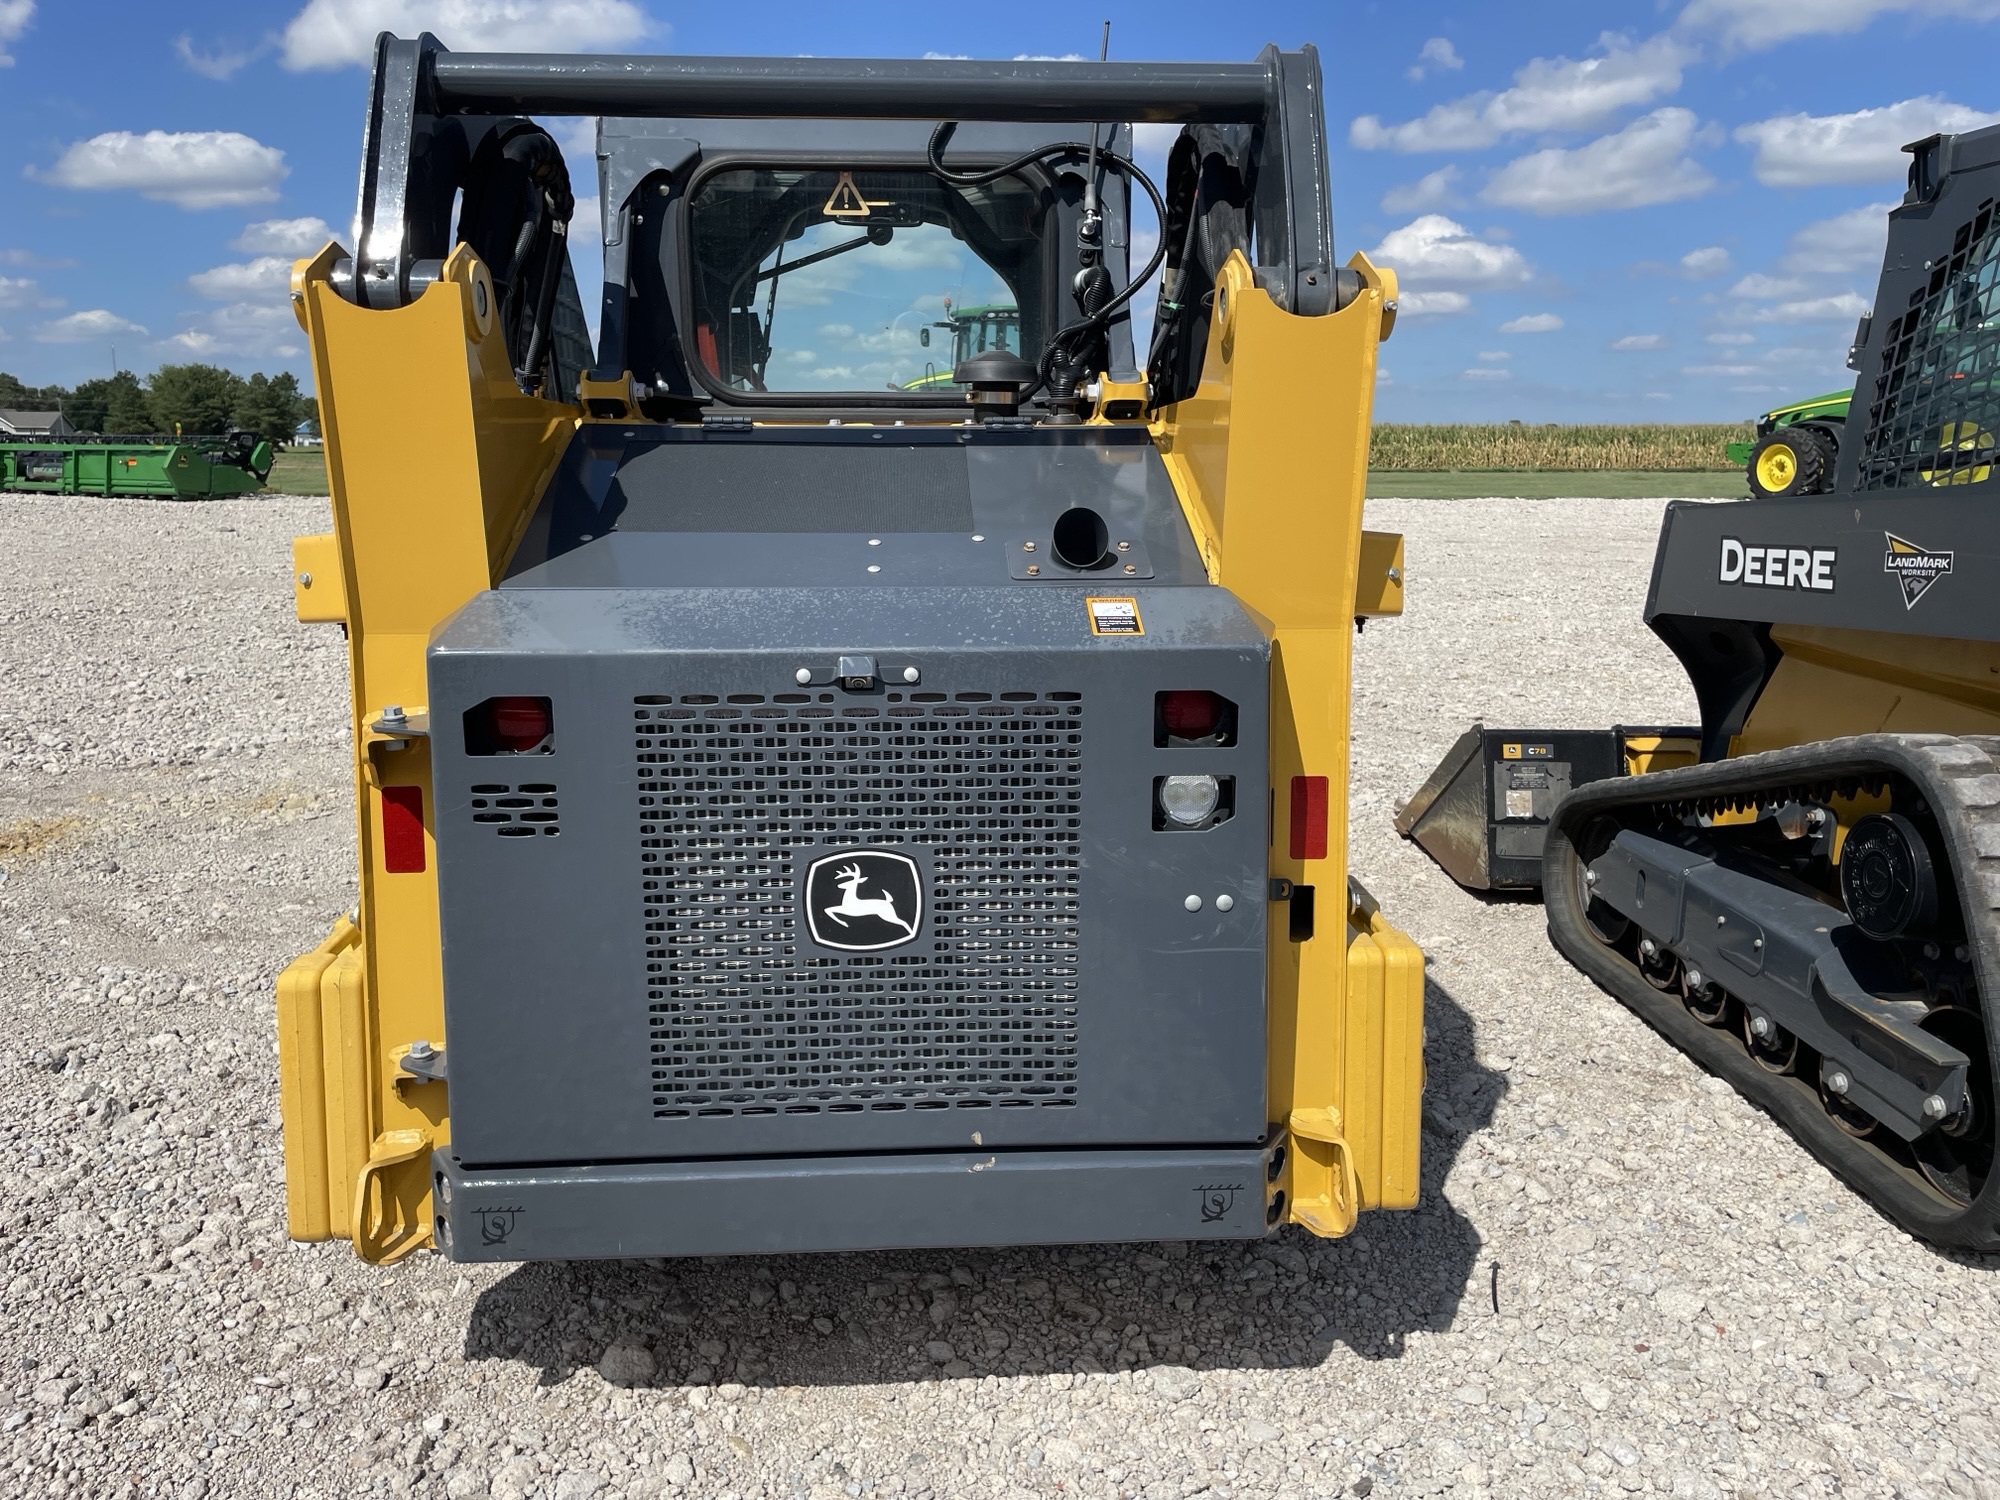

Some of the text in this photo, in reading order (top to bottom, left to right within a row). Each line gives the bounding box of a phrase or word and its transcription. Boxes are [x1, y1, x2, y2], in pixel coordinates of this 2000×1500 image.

[1720, 539, 1835, 590] DEERE
[1901, 569, 1936, 577] WORKSITE
[1528, 747, 1547, 755] C78
